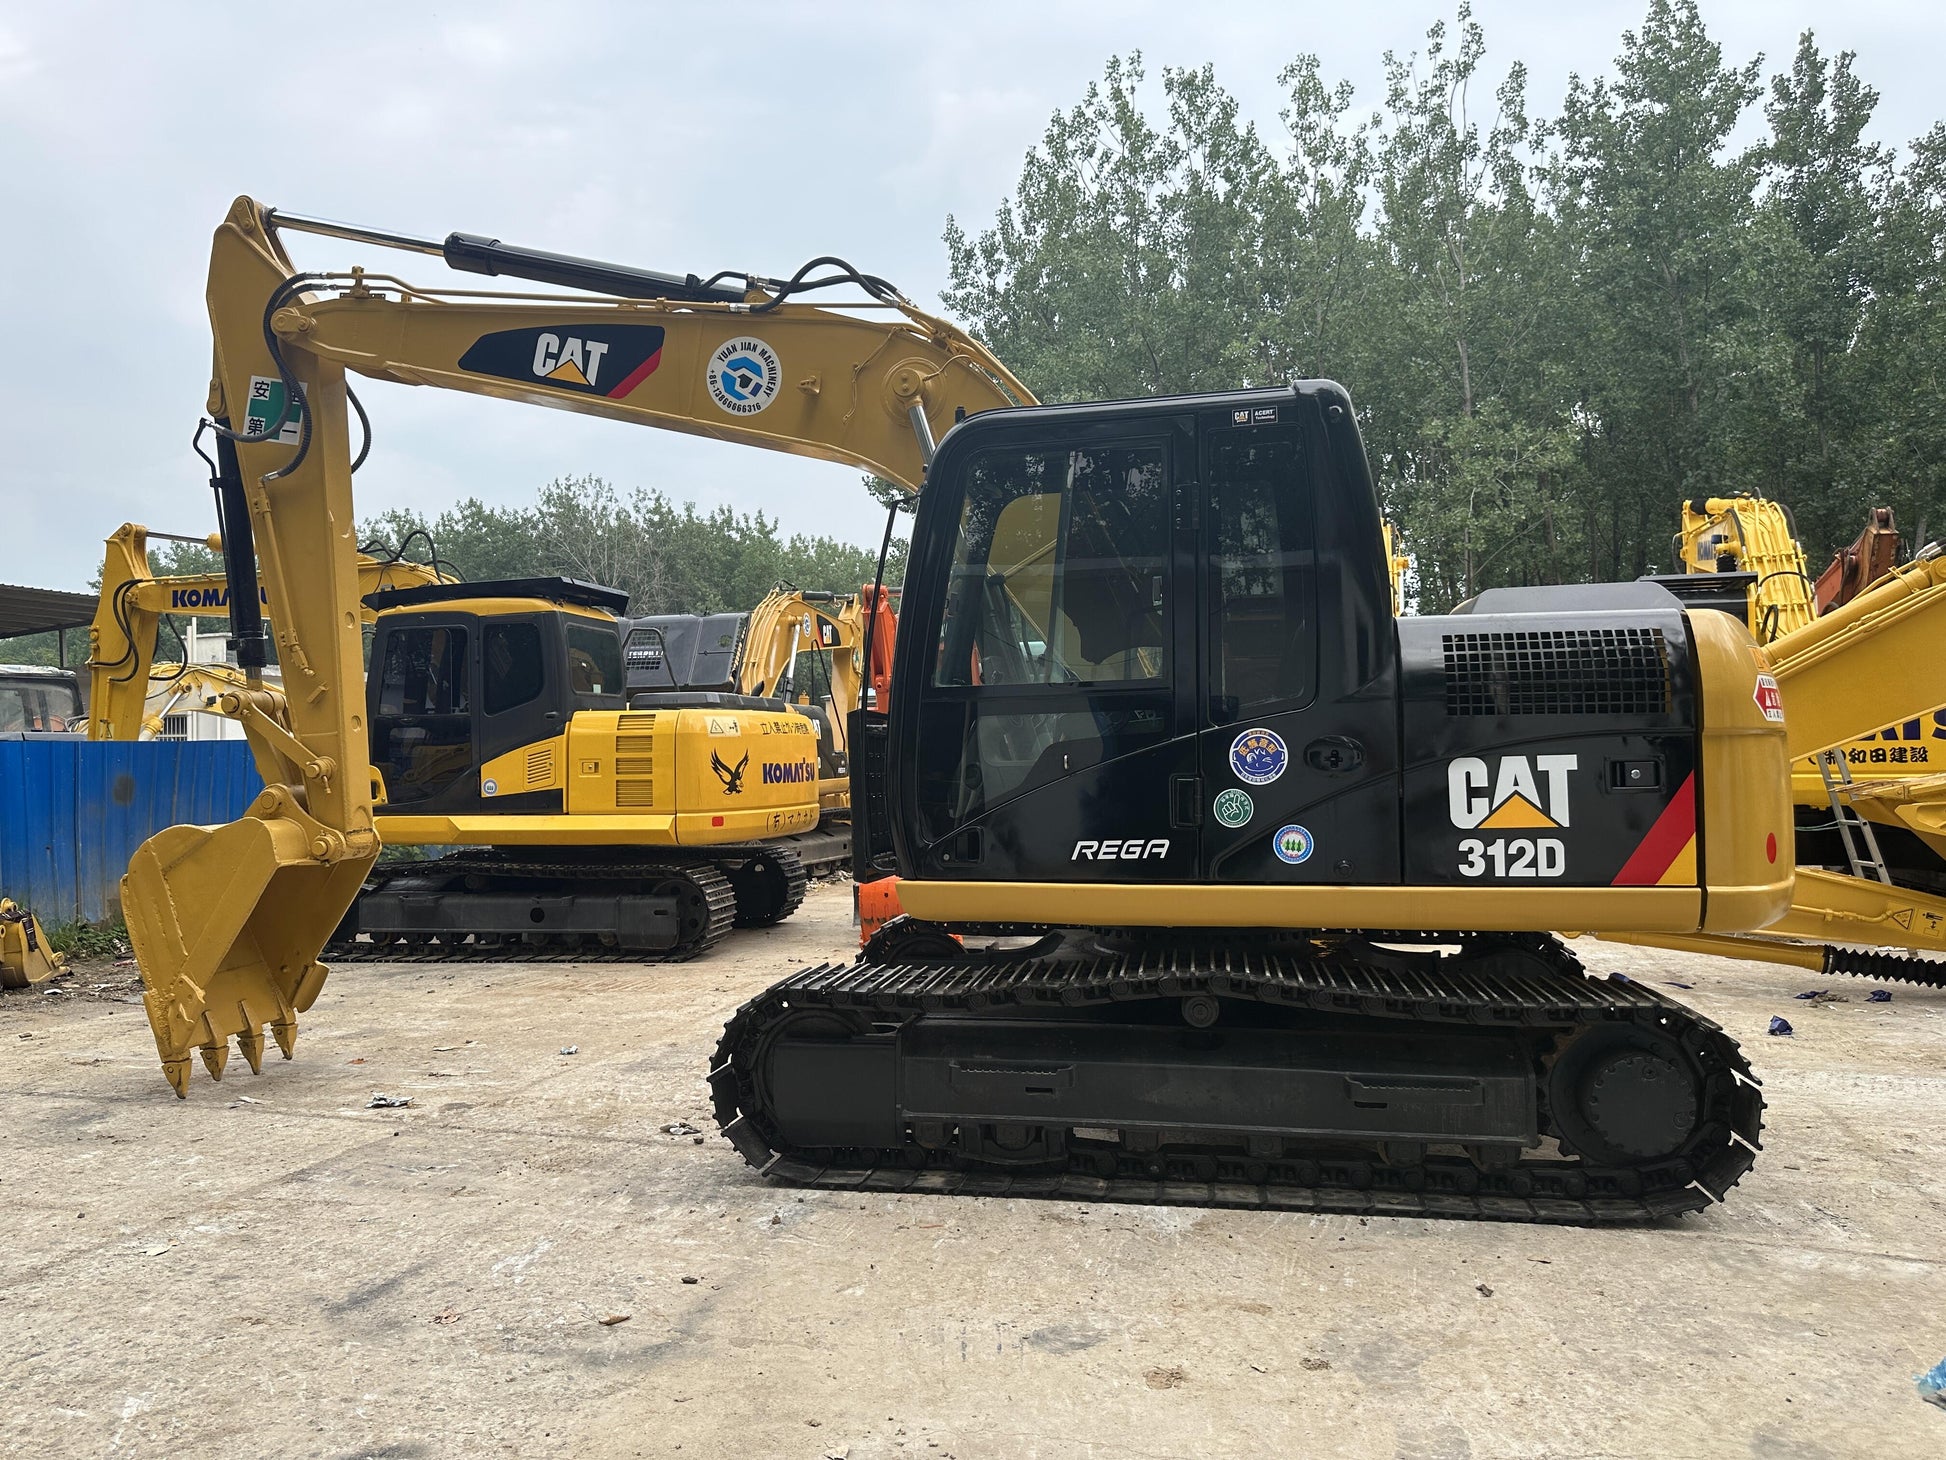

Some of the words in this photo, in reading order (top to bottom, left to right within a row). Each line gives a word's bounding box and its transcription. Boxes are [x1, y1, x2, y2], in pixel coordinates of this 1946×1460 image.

[532, 332, 609, 387] CAT
[716, 343, 738, 362] YUAN
[740, 341, 758, 353] JIAN
[758, 348, 777, 398] MACHINERY
[708, 369, 762, 413] +86-13866666316
[1234, 410, 1249, 421] CAT
[762, 758, 815, 784] KOMATSU
[1447, 754, 1578, 830] CAT
[1071, 839, 1170, 860] REGA
[1458, 838, 1566, 877] 312D
